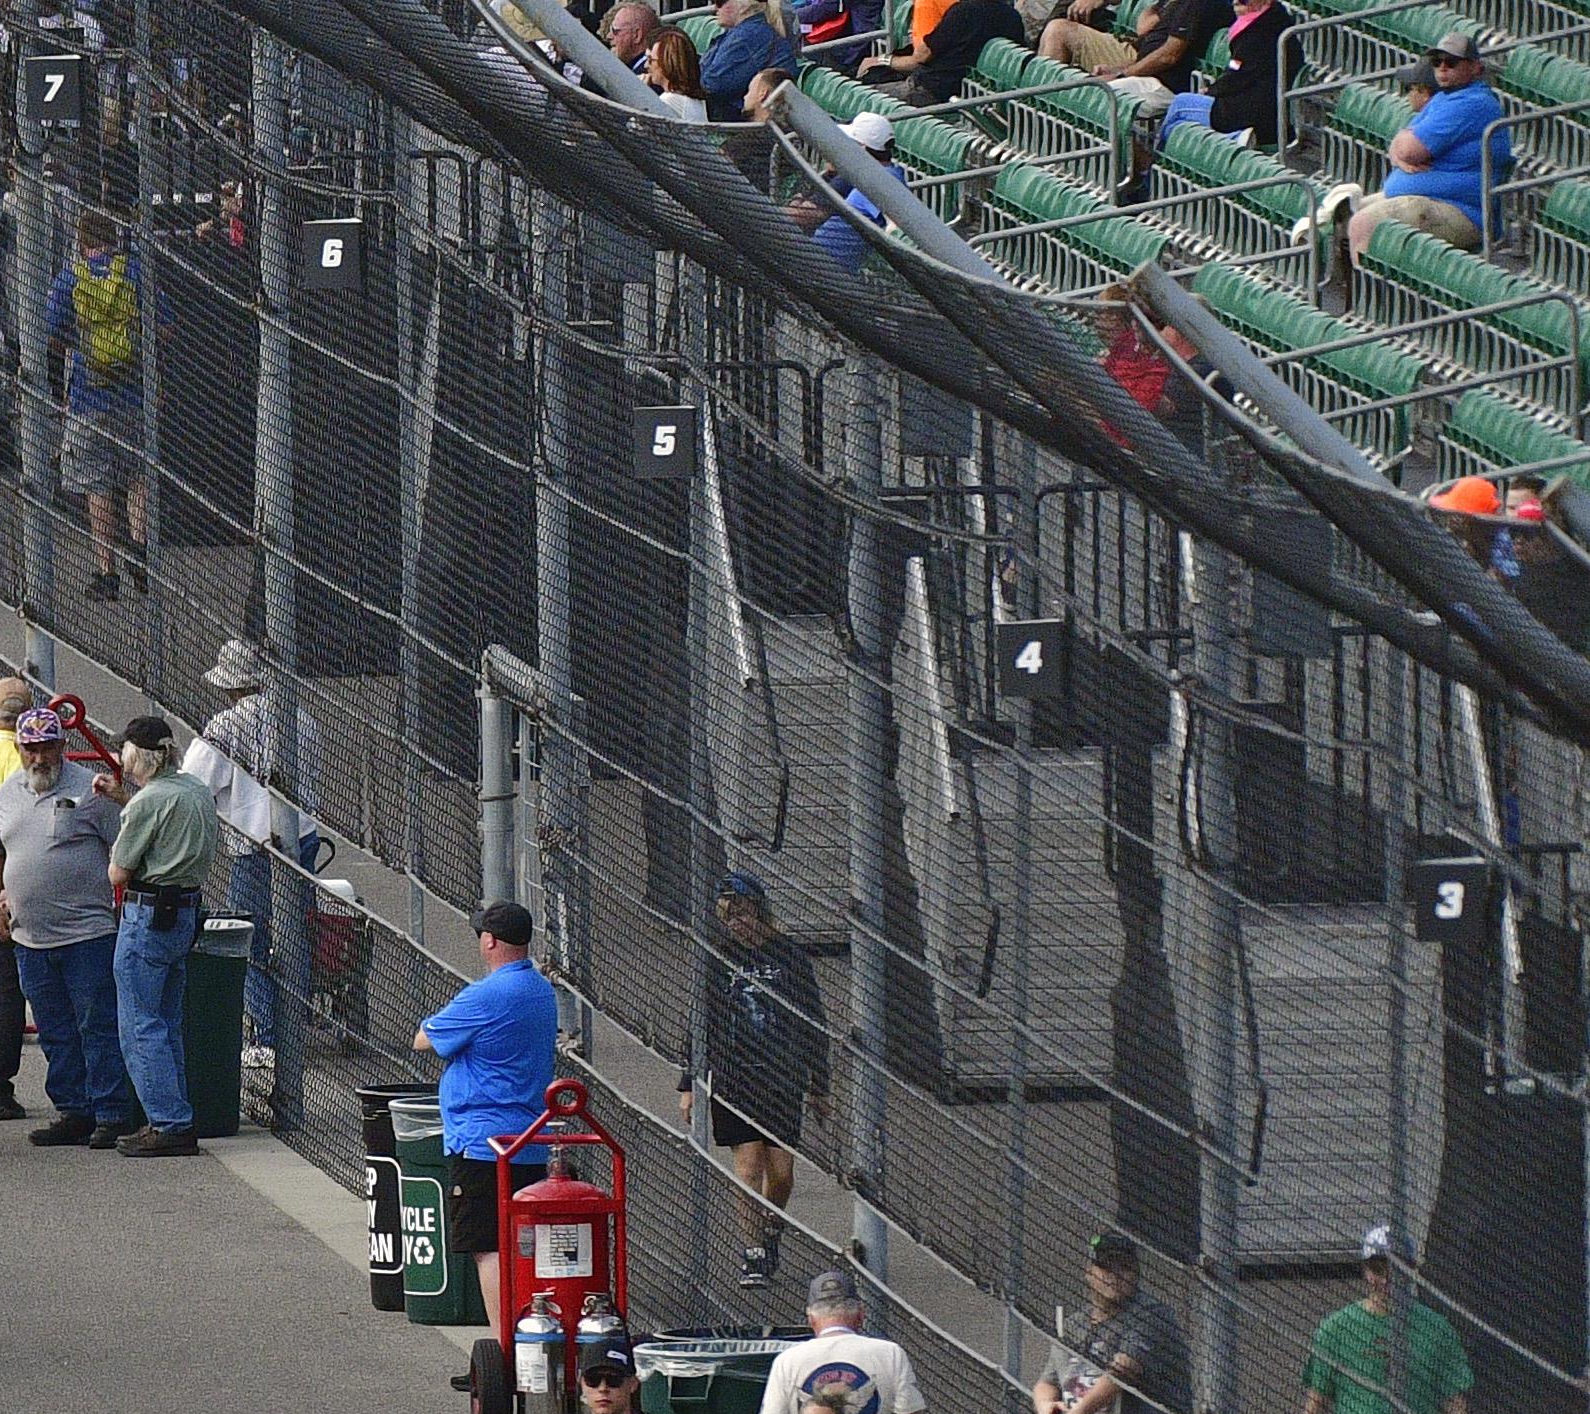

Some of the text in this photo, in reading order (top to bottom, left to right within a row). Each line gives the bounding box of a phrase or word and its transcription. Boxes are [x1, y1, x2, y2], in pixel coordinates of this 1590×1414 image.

[43, 74, 65, 103] 7
[321, 238, 344, 268] 6
[652, 425, 677, 457] 5
[1015, 640, 1043, 675] 4
[1435, 881, 1465, 920] 3
